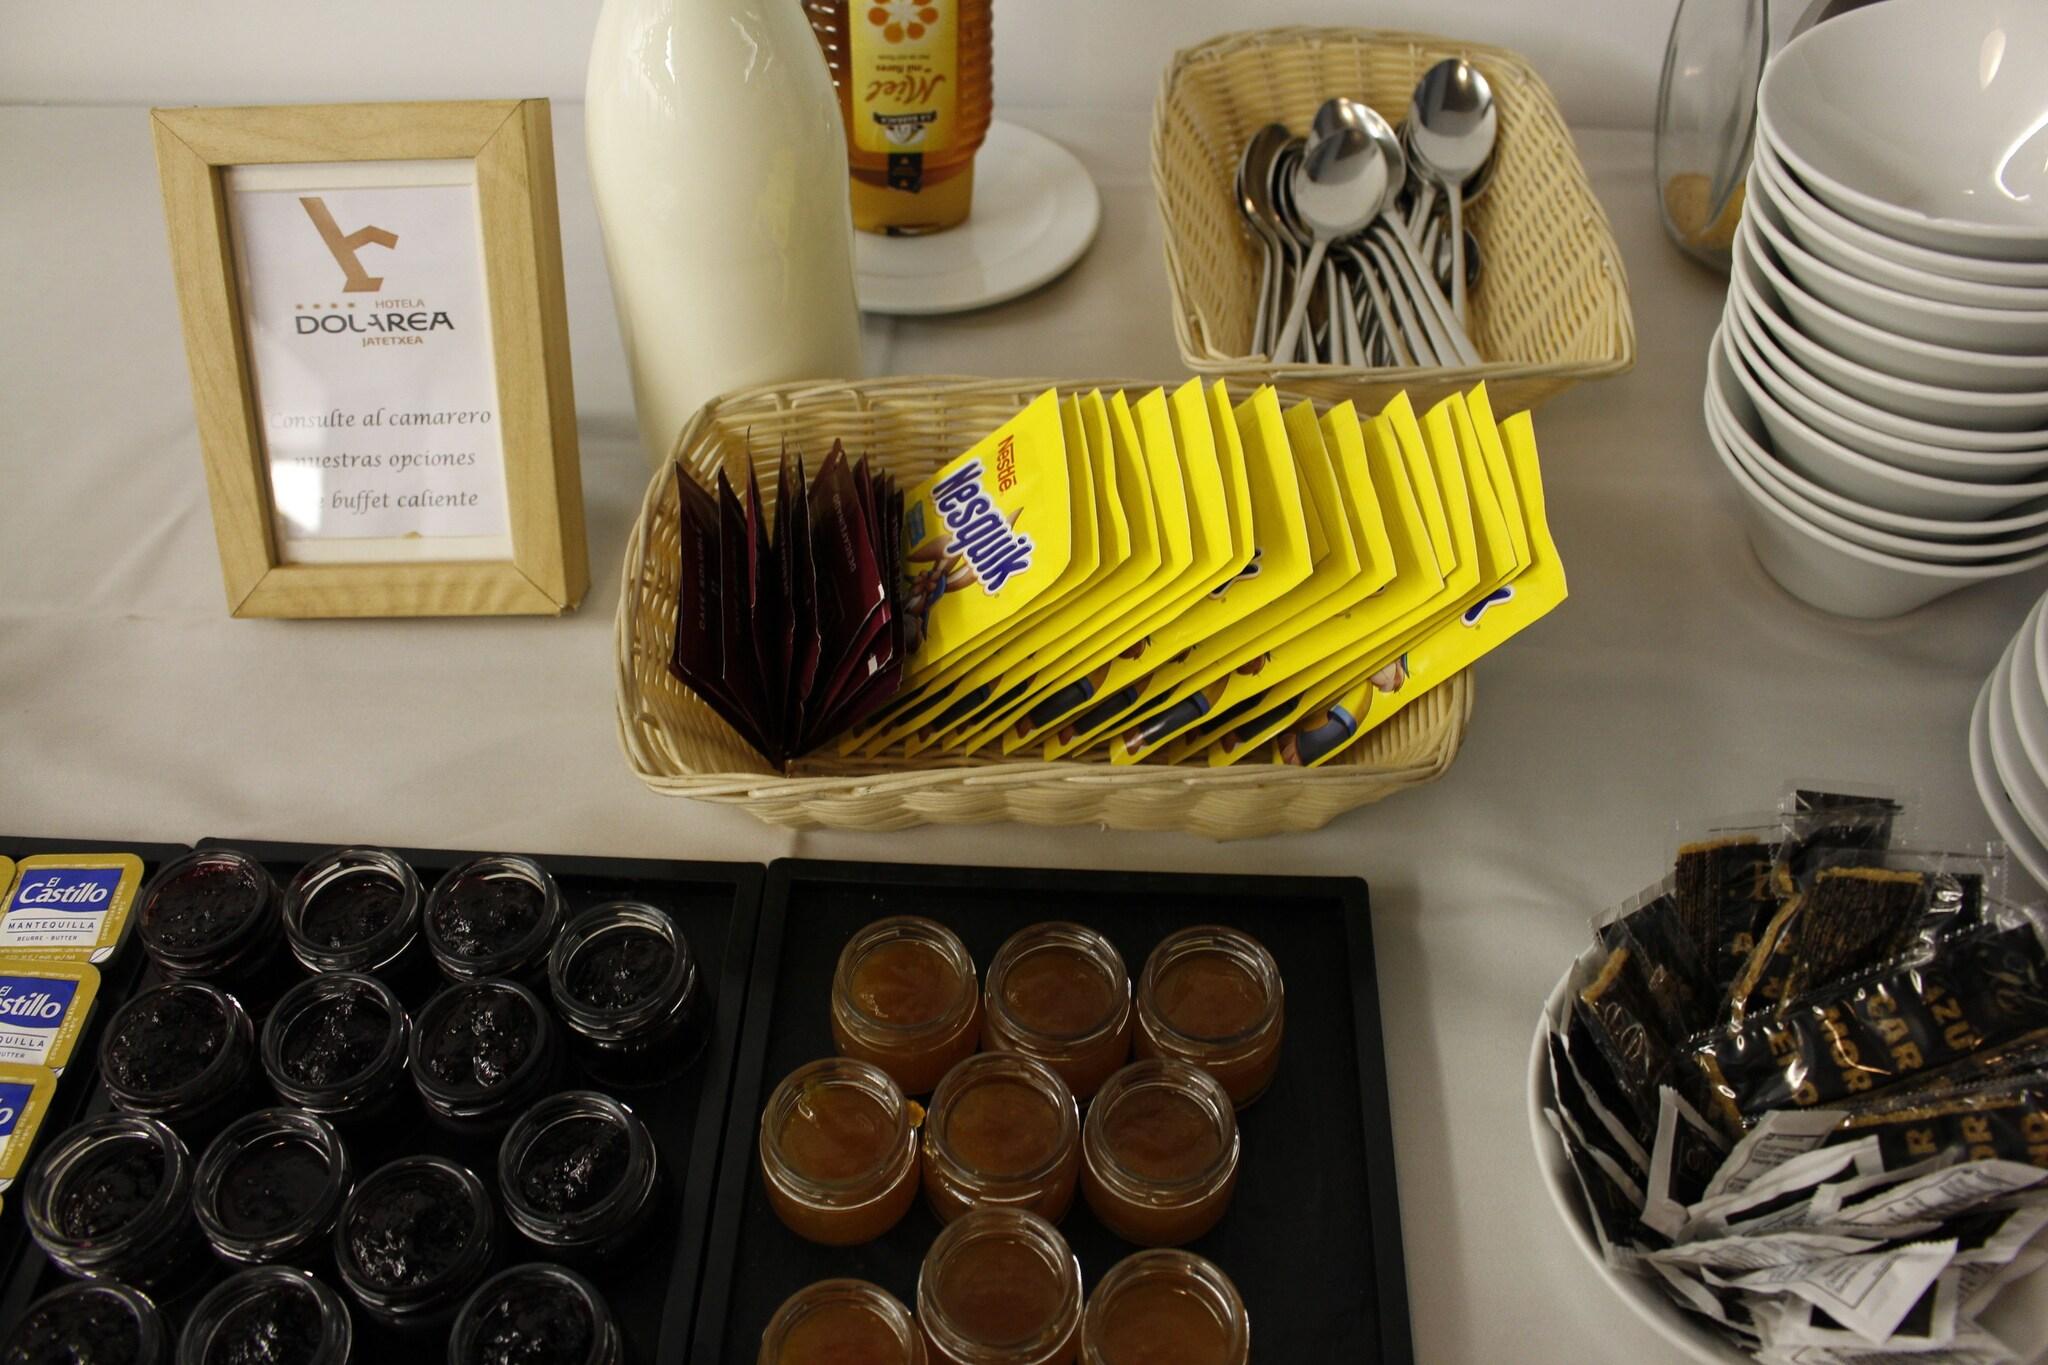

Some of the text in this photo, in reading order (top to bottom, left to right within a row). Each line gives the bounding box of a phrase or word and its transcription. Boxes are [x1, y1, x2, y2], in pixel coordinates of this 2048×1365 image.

[865, 74, 946, 104] Miel
[375, 299, 425, 310] HOTELA
[295, 311, 455, 335] DOLAREA
[362, 336, 424, 348] JATETXEA
[362, 408, 385, 427] al
[389, 409, 492, 427] camarero
[389, 451, 476, 472] opciones
[332, 489, 390, 515] buffet
[397, 489, 479, 508] caliente
[19, 882, 108, 903] Castillo
[46, 877, 61, 887] El
[8, 921, 95, 930] MANTEQUILLA
[0, 992, 61, 1018] stillo
[1867, 993, 1924, 1072] CAR
